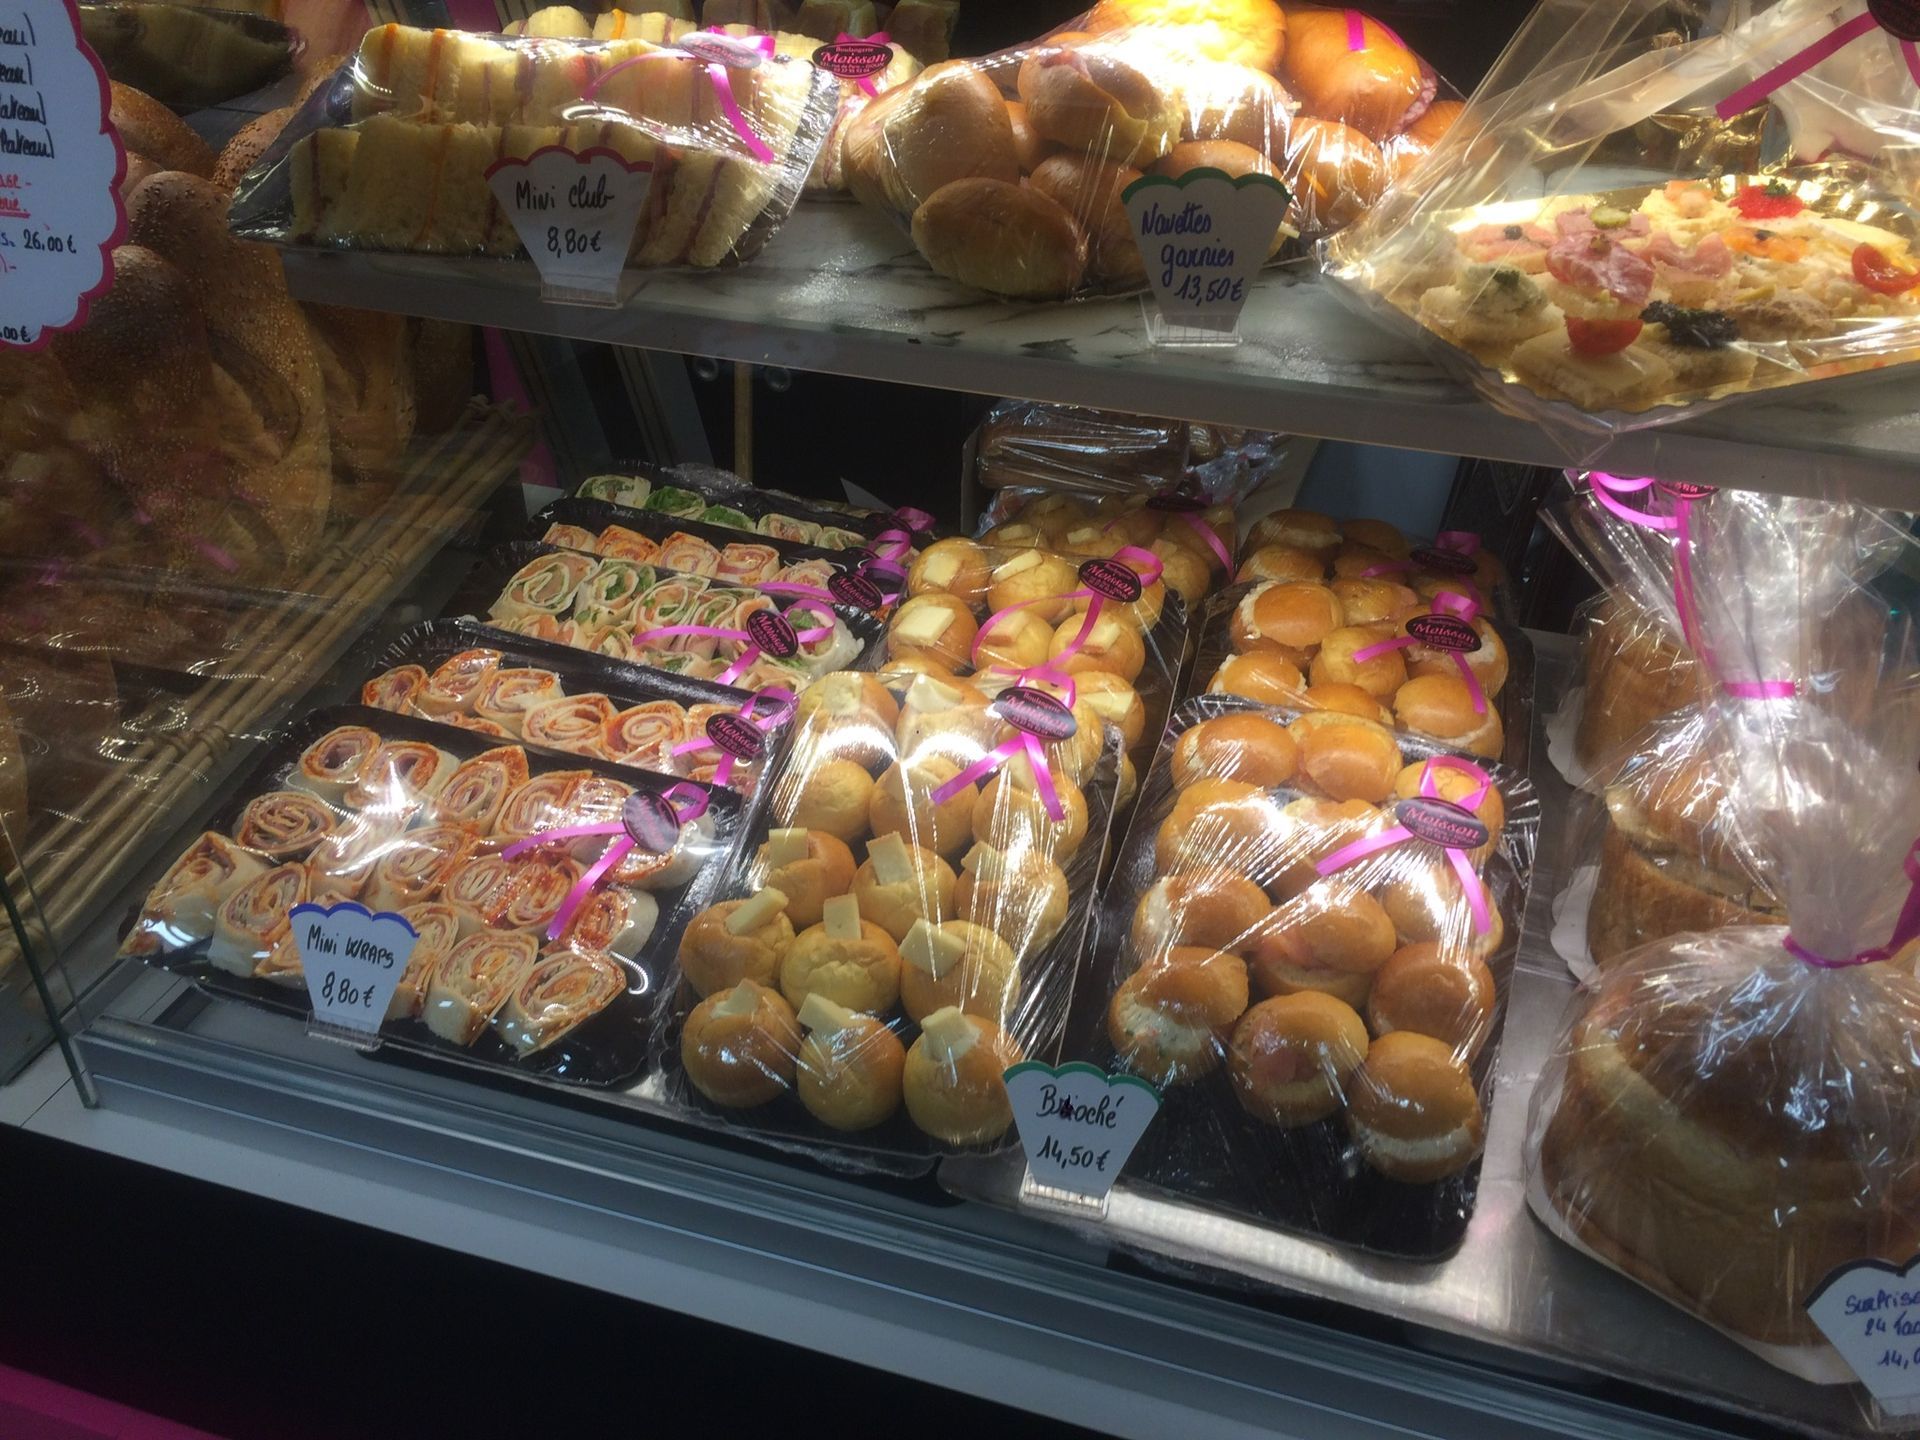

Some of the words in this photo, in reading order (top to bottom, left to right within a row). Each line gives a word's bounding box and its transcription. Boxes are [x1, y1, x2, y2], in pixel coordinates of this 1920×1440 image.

[516, 180, 555, 211] Mini
[1141, 202, 1212, 236] Navettes
[547, 226, 602, 258] 8,80€
[1161, 237, 1235, 287] garnies
[307, 923, 337, 956] Mini
[345, 936, 394, 969] WRAPS
[321, 970, 376, 1009] 8,80€
[1036, 1135, 1110, 1171] 14,50€
